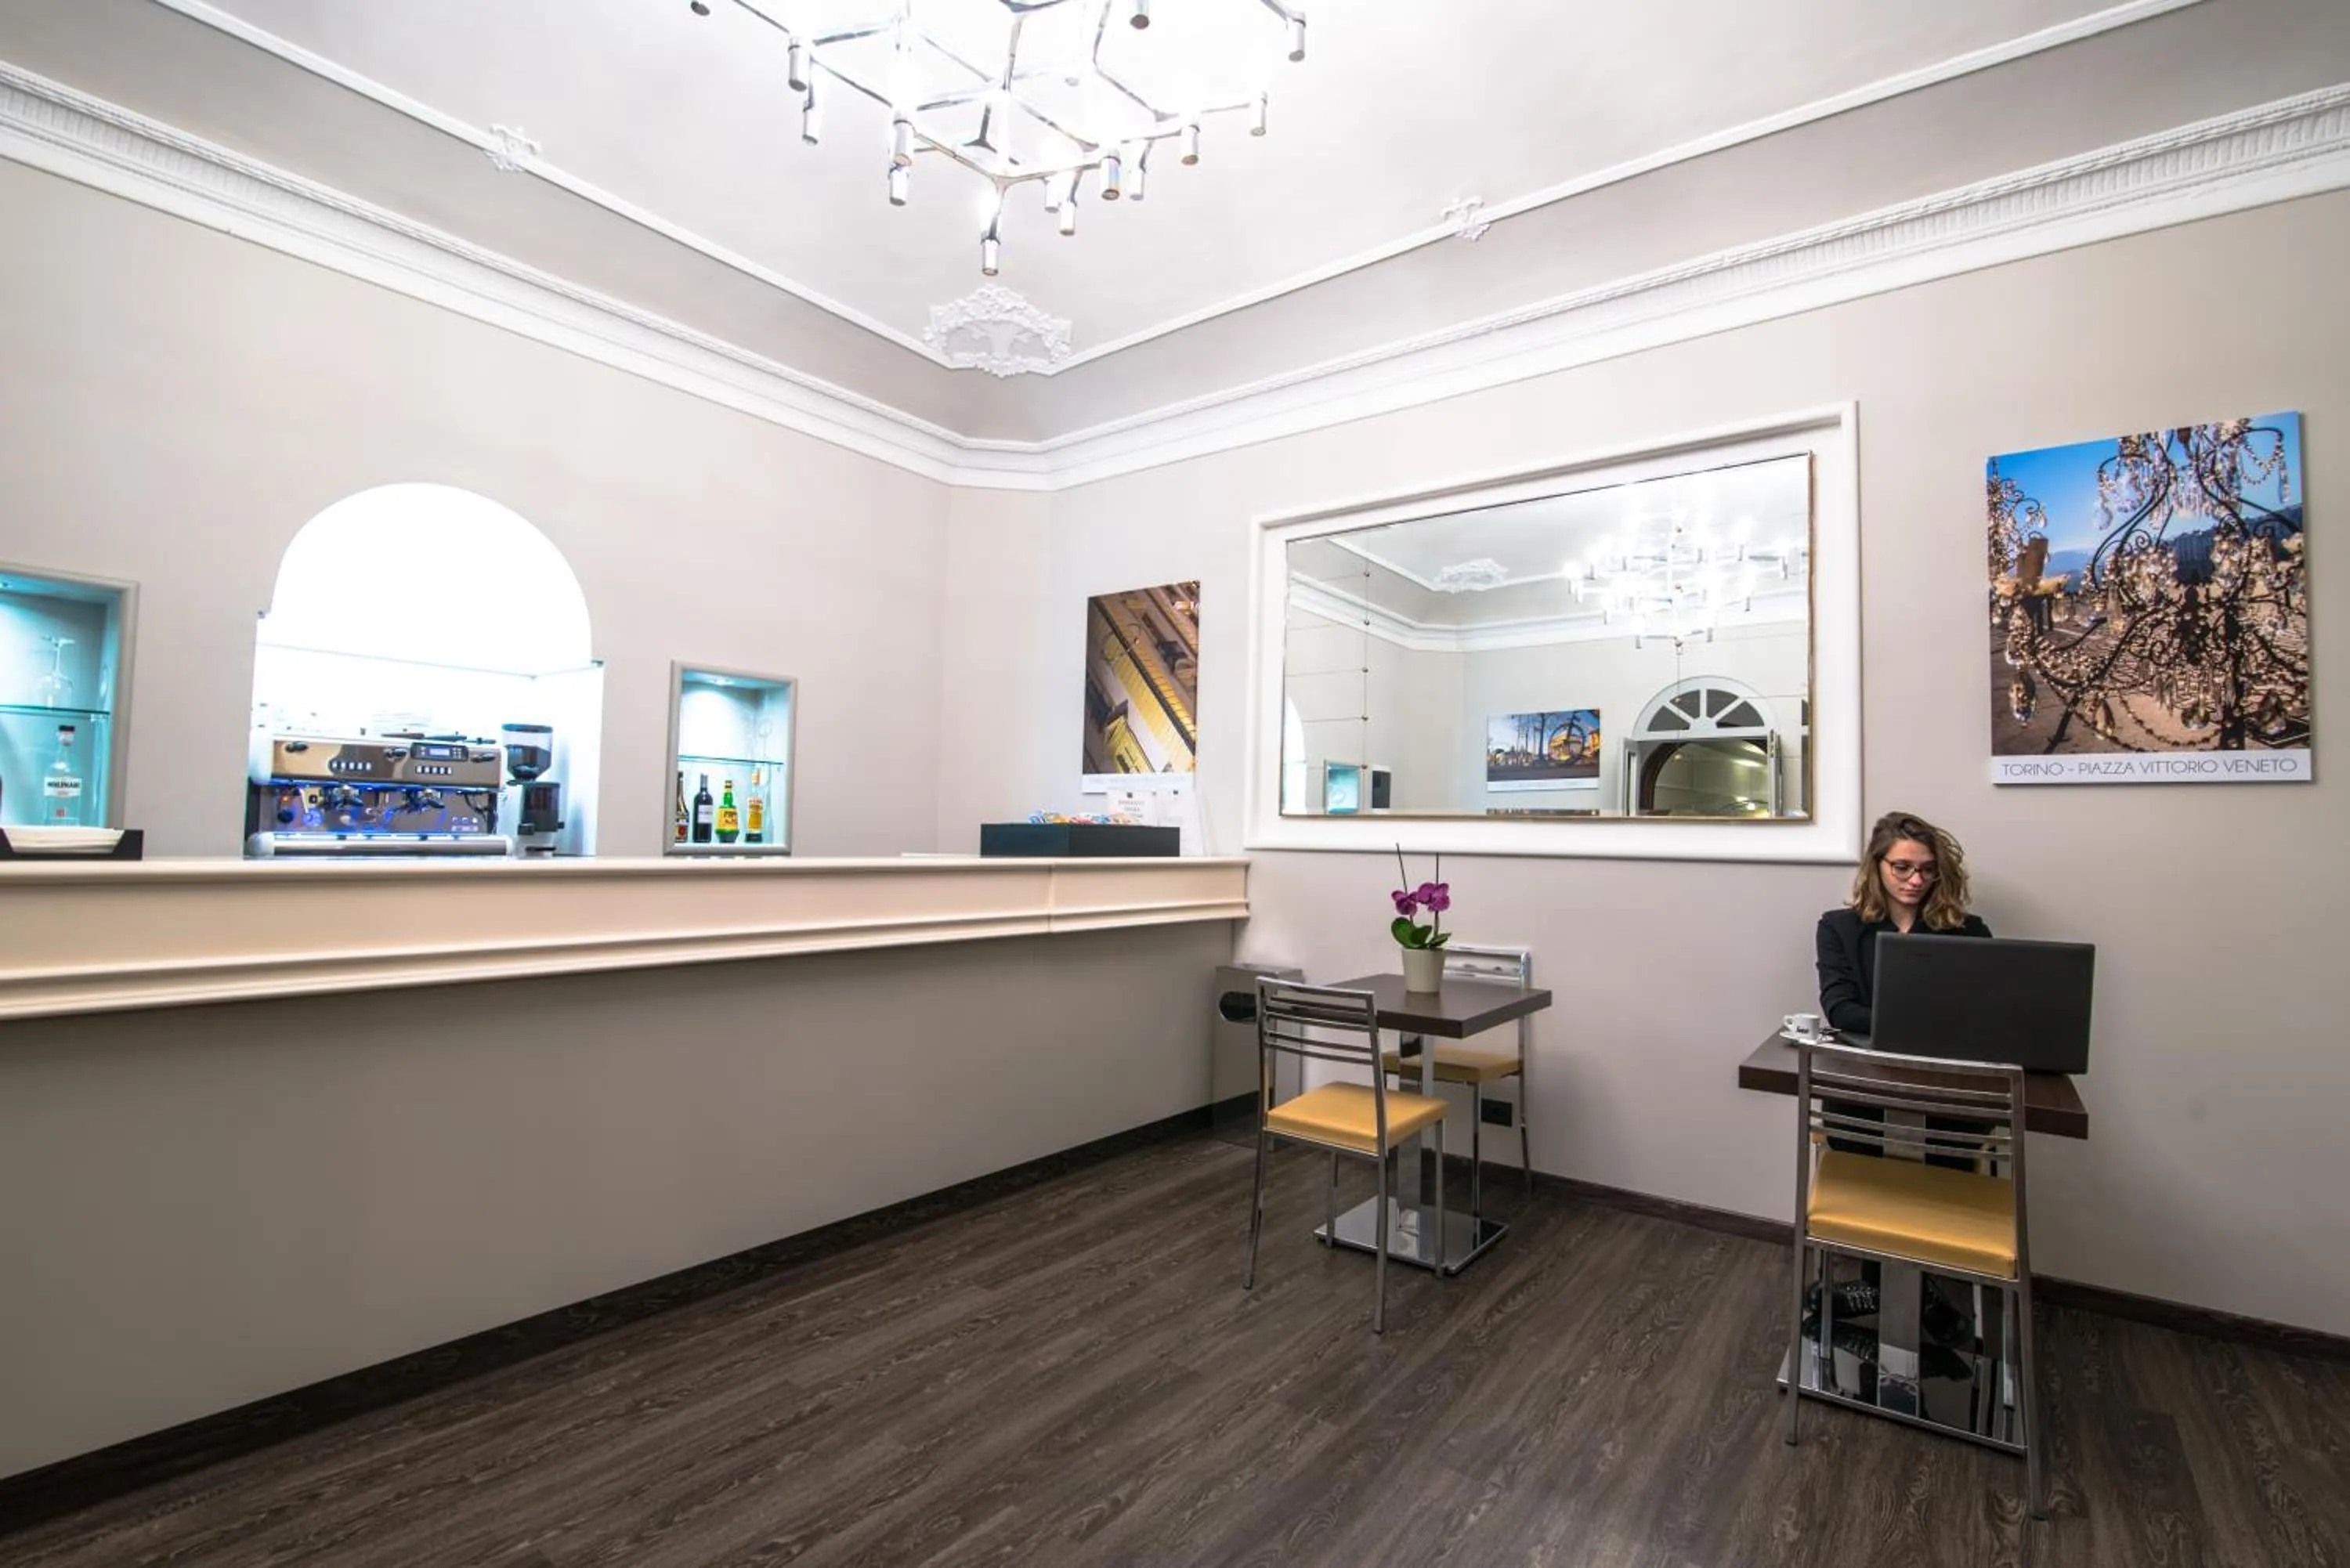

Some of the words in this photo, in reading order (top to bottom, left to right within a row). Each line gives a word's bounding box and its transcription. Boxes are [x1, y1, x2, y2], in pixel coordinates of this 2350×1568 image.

[2001, 762, 2065, 777] TORINO
[2077, 761, 2135, 775] PIAZZA
[2139, 759, 2218, 774] VITTORIO
[2223, 757, 2298, 773] VENETO
